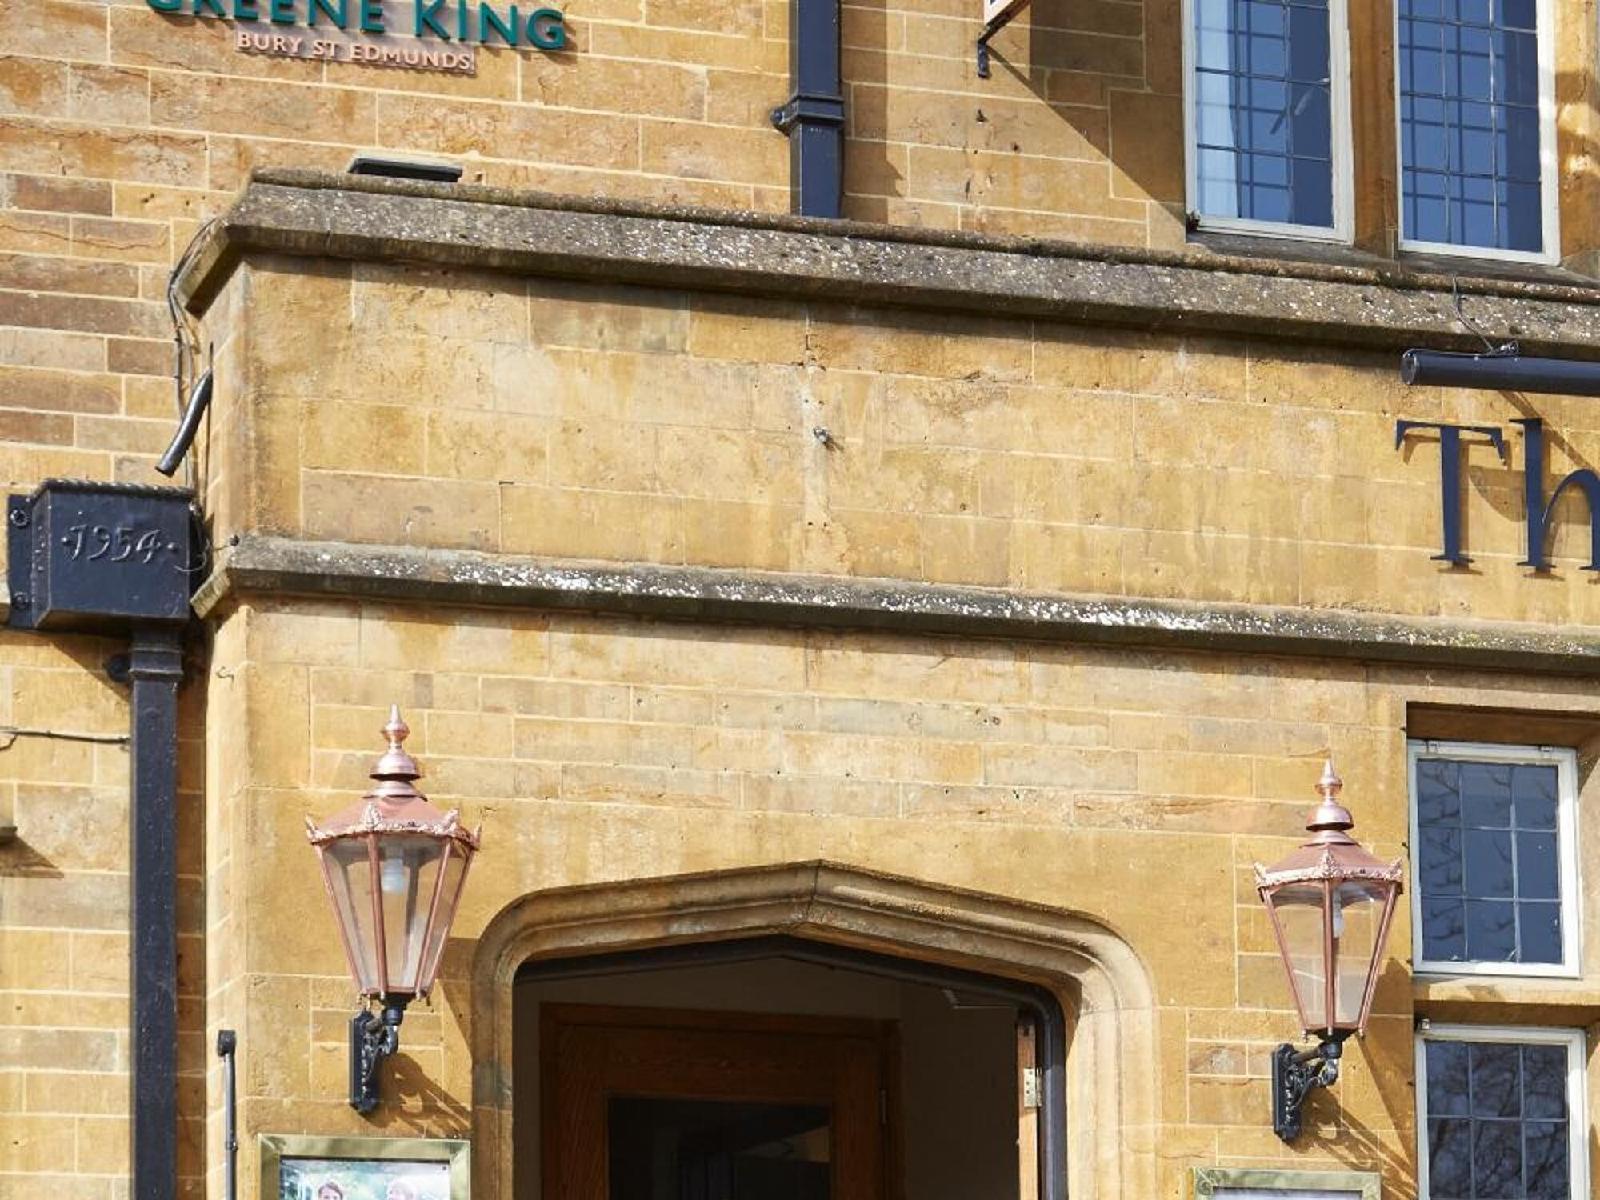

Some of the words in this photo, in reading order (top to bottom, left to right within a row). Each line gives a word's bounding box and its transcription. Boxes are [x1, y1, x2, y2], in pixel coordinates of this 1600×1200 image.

[148, 0, 385, 33] ENE
[414, 0, 567, 50] KING
[237, 31, 303, 53] BURY
[312, 39, 339, 58] ST
[349, 43, 471, 70] EDMUNDS
